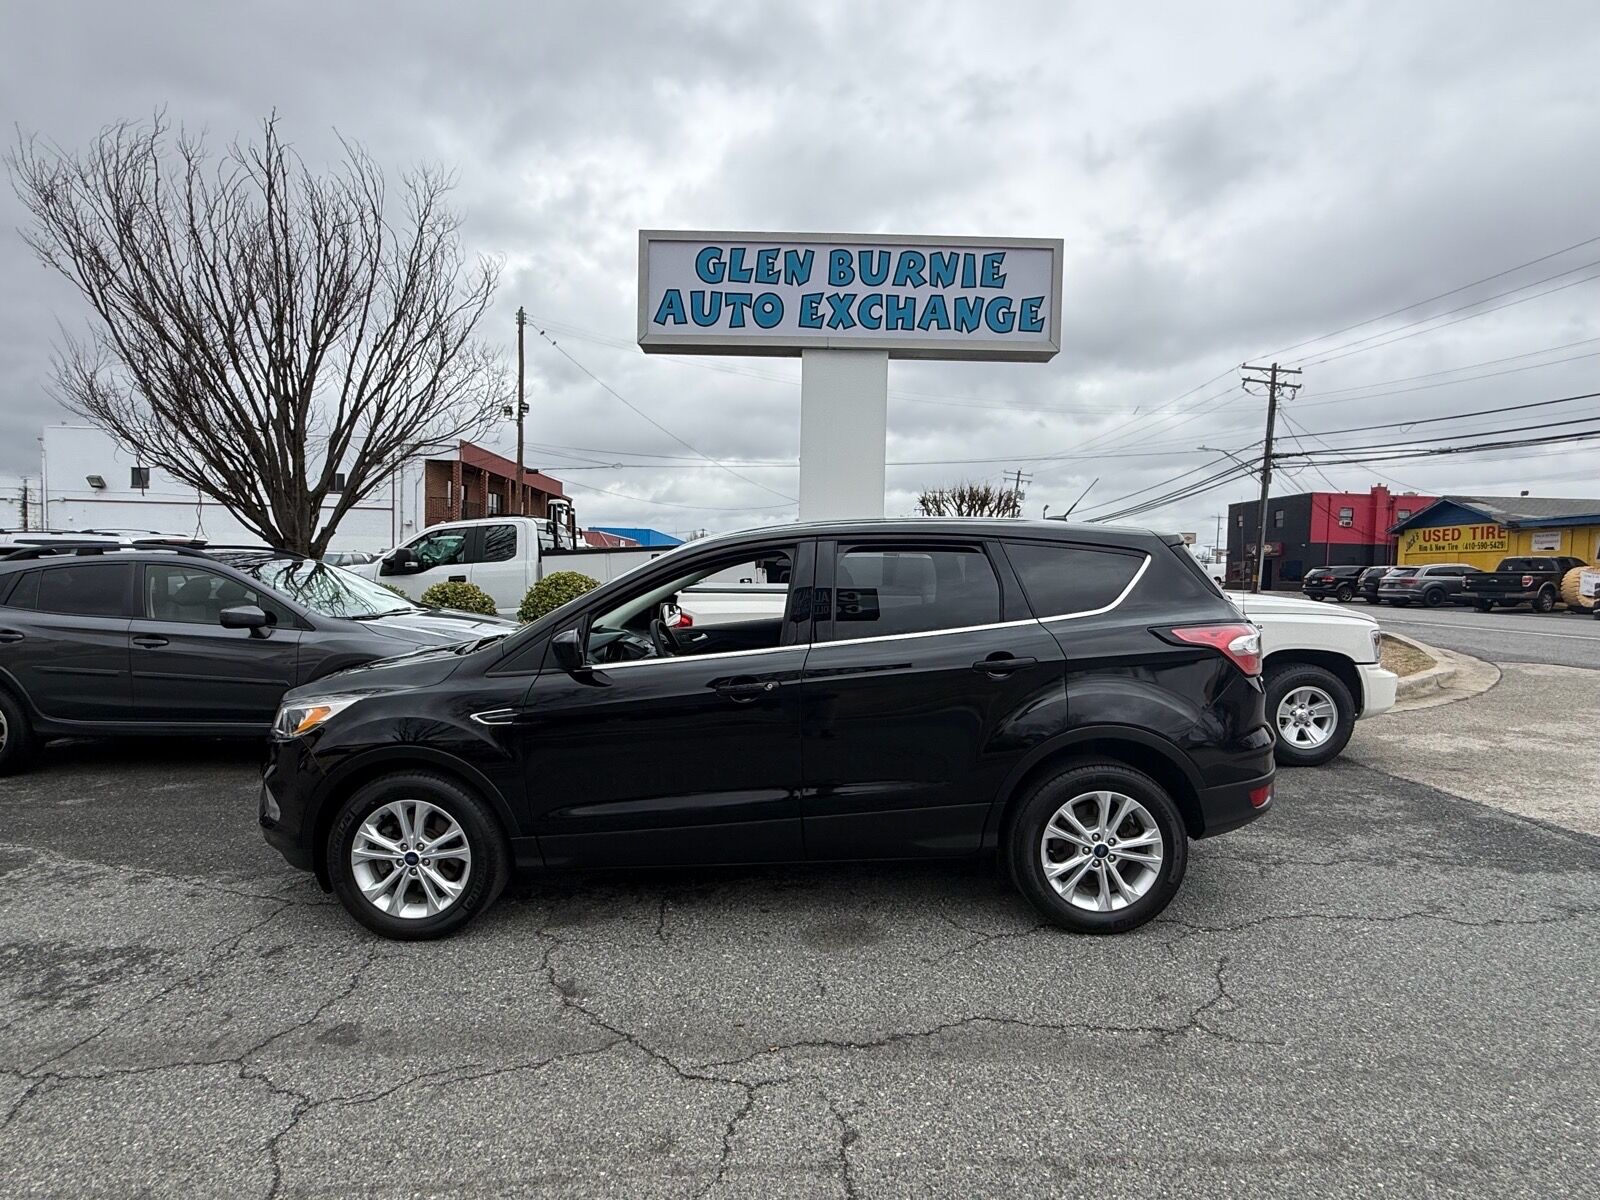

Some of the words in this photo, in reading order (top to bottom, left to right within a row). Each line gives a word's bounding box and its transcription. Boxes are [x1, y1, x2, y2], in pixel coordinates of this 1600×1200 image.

[695, 246, 815, 286] GLEN
[828, 249, 1007, 289] BURNIE
[653, 288, 785, 329] AUTO
[799, 292, 1045, 334] EXCHANGE
[1422, 528, 1462, 542] USED
[1469, 526, 1506, 540] TIRE
[1434, 543, 1446, 551] New
[1447, 543, 1459, 551] Tire
